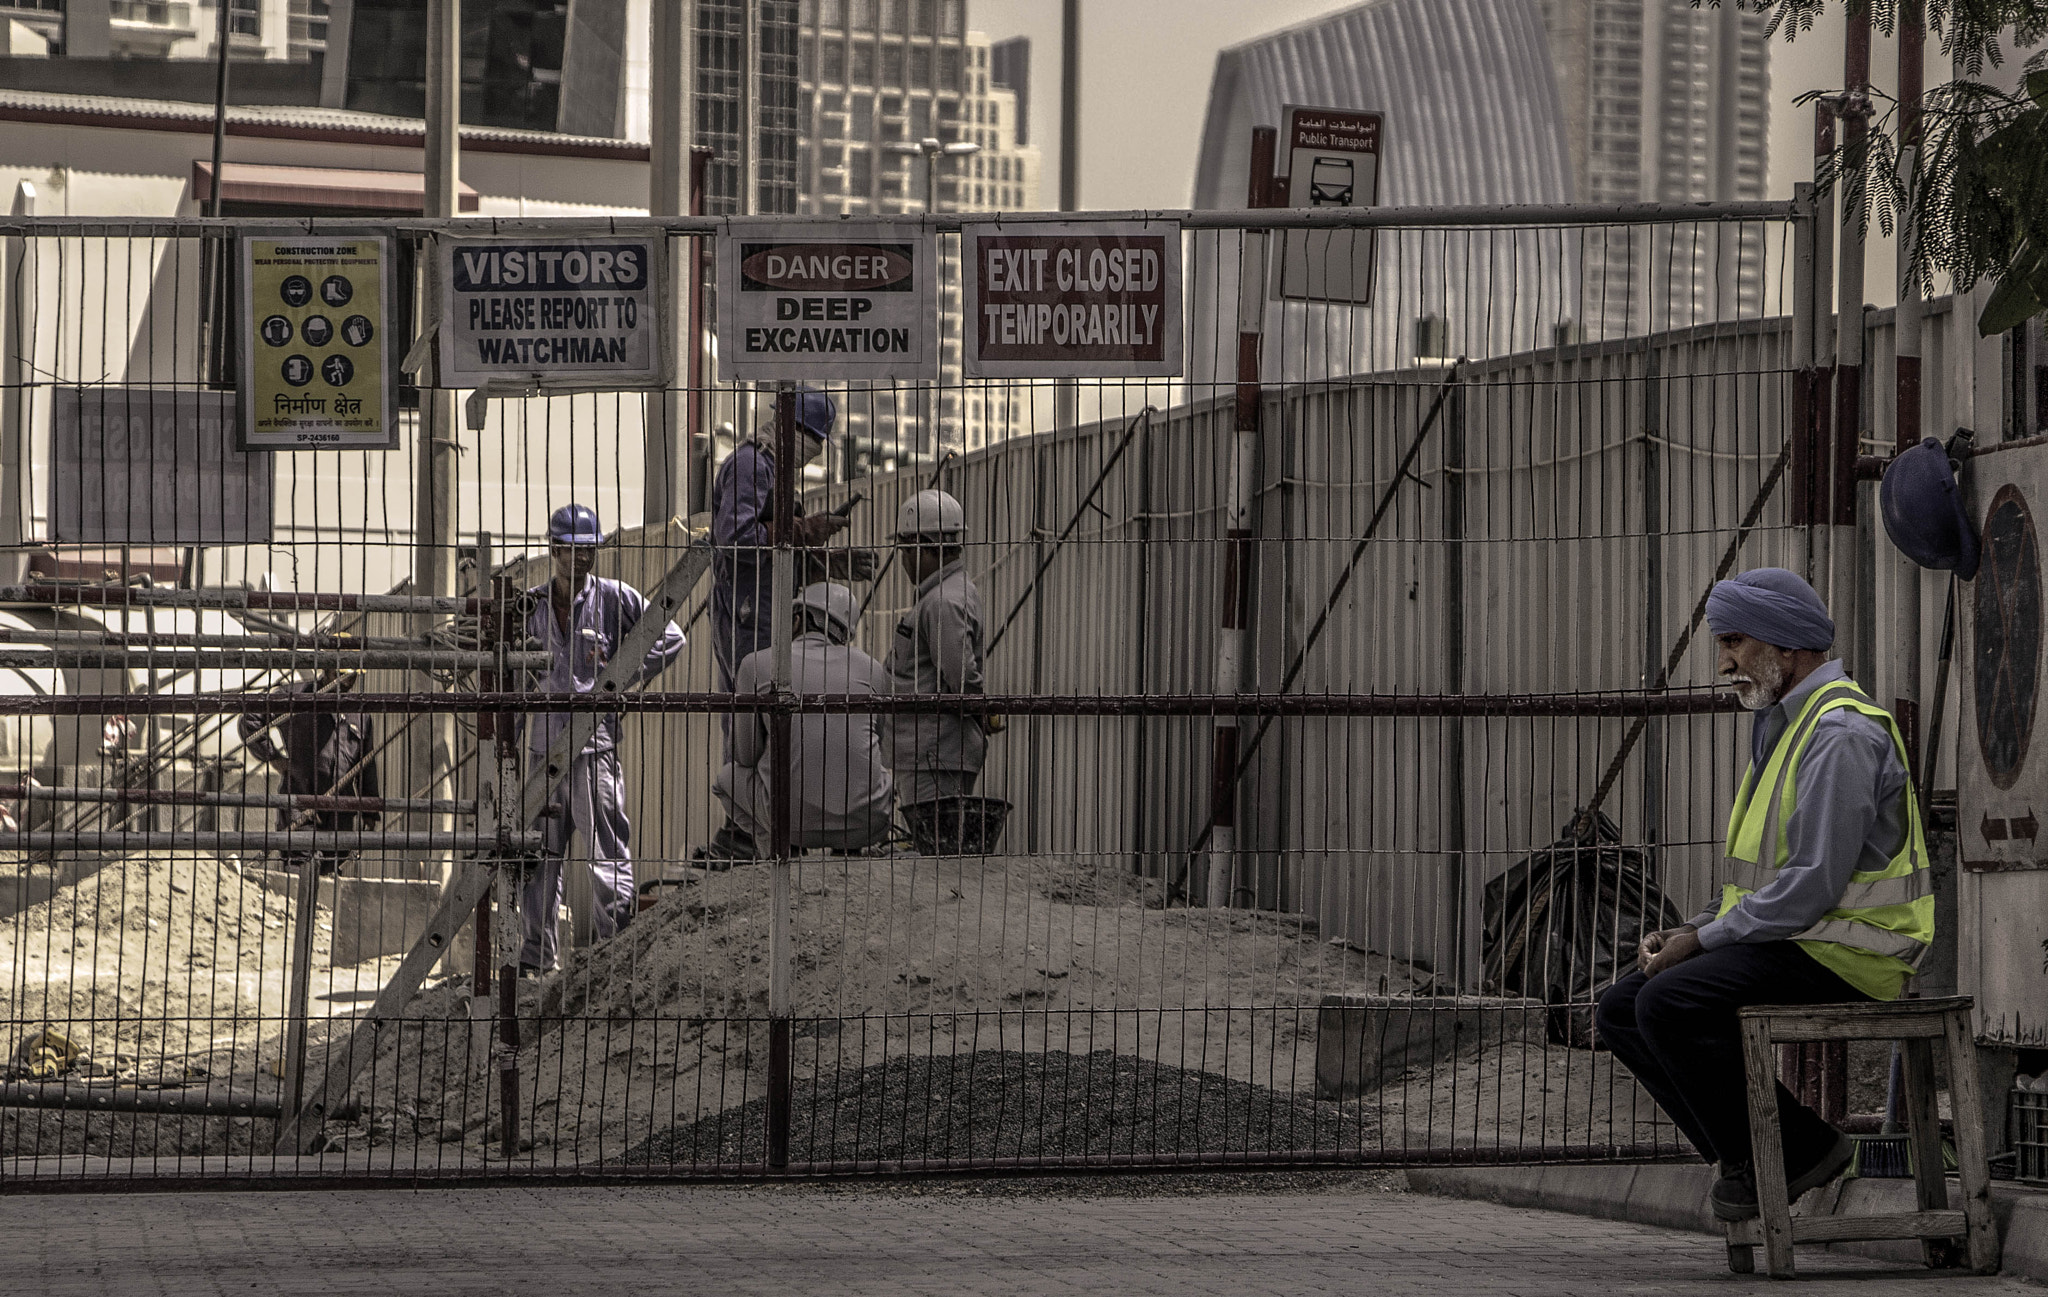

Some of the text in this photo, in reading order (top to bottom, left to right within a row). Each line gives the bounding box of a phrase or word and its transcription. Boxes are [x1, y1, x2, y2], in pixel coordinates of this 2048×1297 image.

[1298, 117, 1376, 133] المواصلات العامة
[1299, 131, 1373, 150] Public Transport
[274, 246, 358, 255] CONSTRUCTION ZONE
[463, 250, 639, 284] VISITORS
[767, 255, 889, 280] DANGER
[988, 248, 1159, 292] EXIT CLOSED
[469, 296, 638, 330] PLEASE REPORT TO
[776, 297, 873, 321] DEEP
[984, 303, 1159, 345] TEMPORARILY
[478, 337, 627, 364] WATCHMAN
[745, 328, 909, 353] EXCAVATION
[273, 392, 363, 417] निर्माण क्षेत्र
